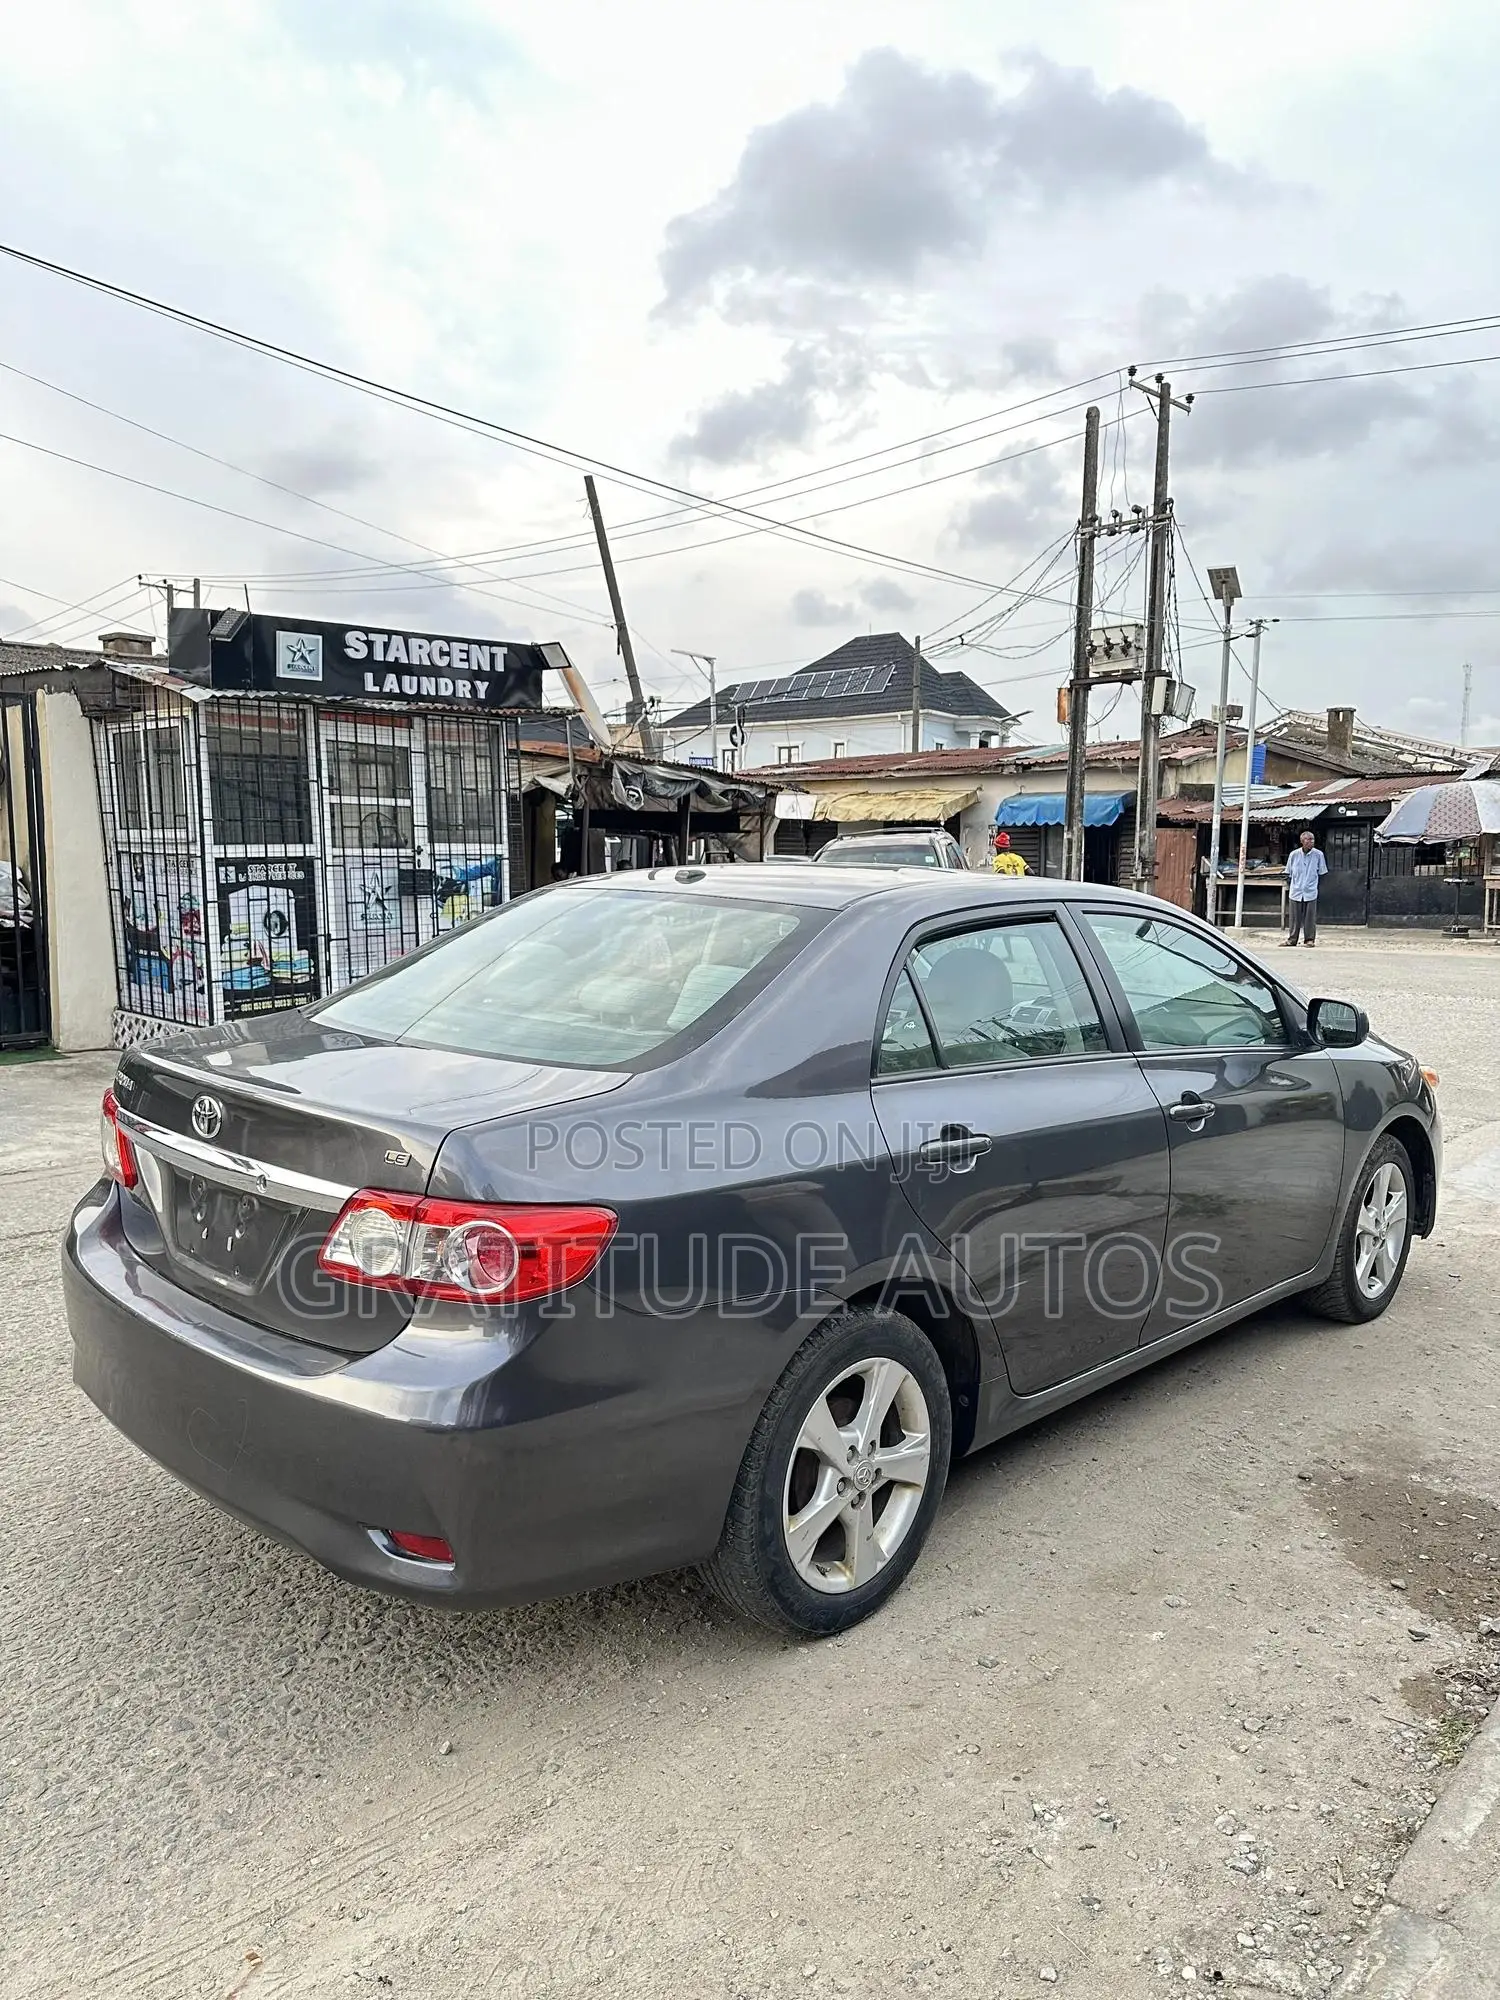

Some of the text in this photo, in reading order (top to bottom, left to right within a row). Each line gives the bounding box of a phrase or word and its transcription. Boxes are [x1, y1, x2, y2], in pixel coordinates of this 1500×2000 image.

[343, 630, 508, 673] STARCENT
[363, 672, 490, 699] LAUNDRY
[384, 1150, 411, 1167] LE
